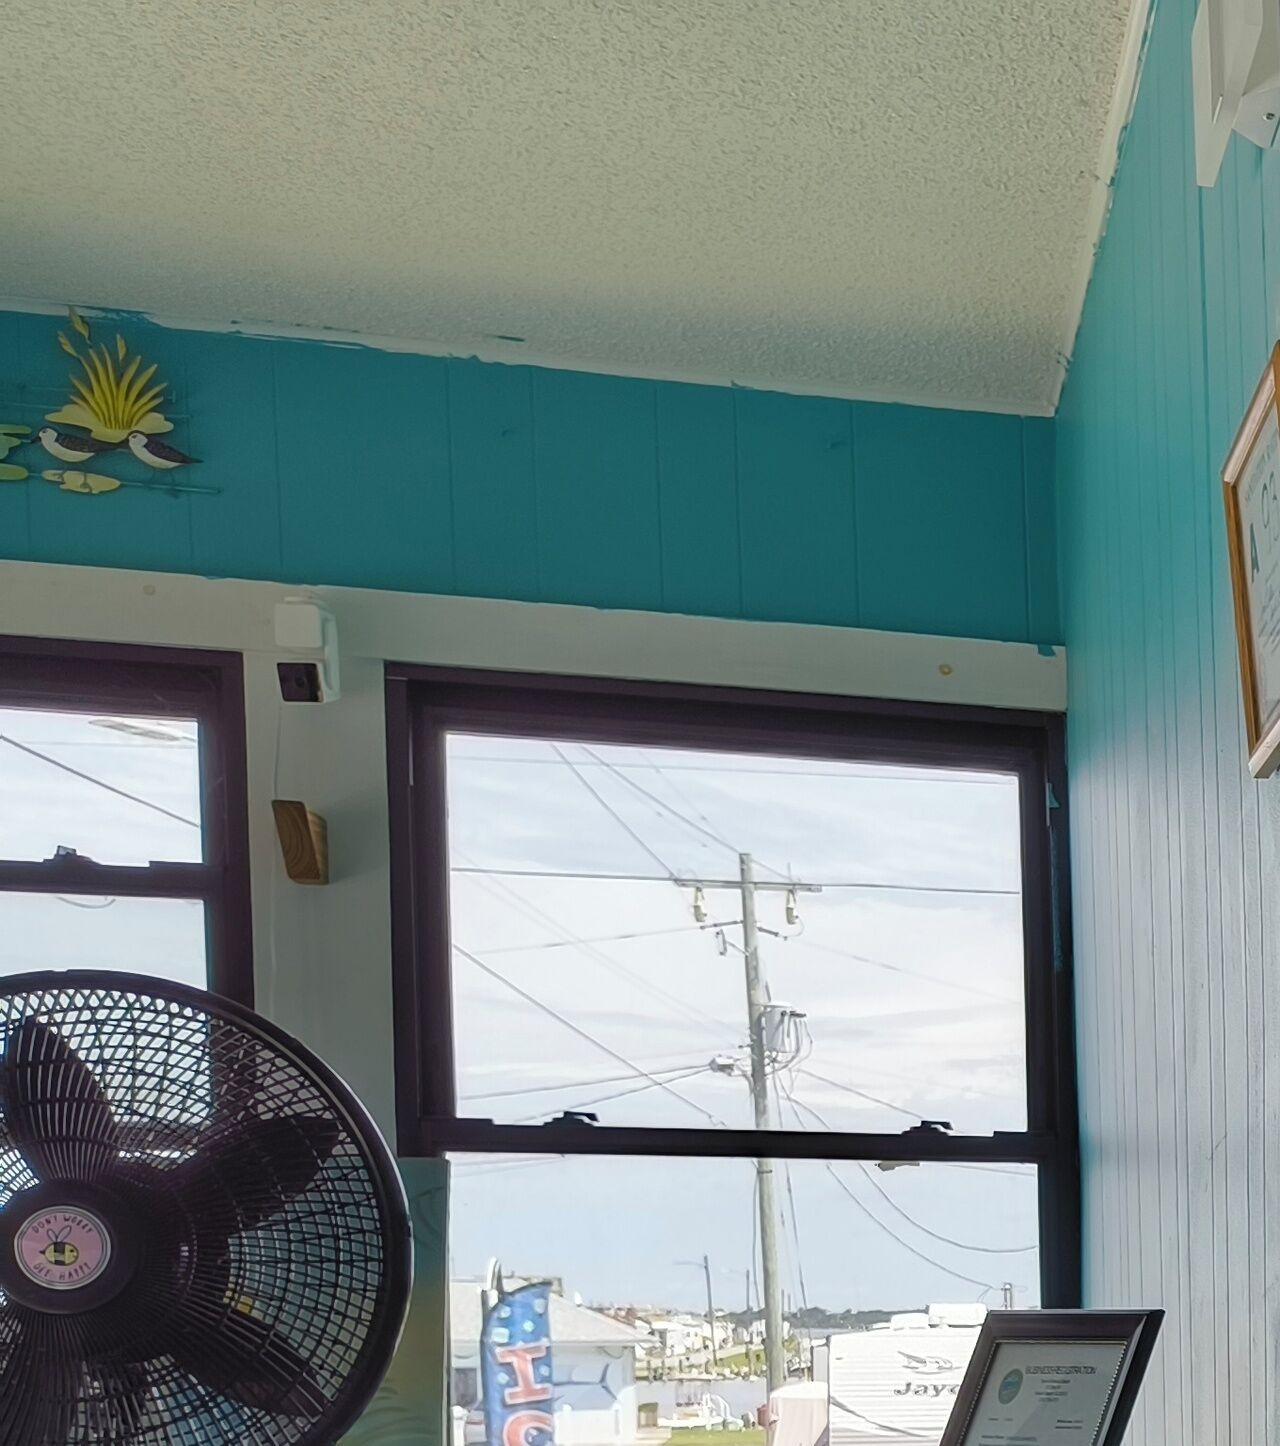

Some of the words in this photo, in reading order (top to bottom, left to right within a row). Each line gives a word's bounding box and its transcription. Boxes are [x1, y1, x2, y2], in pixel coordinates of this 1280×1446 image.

[31, 1215, 58, 1235] DON'T
[63, 1214, 94, 1234] WORRY
[32, 1262, 52, 1278] BEE
[58, 1262, 92, 1281] HAPPY
